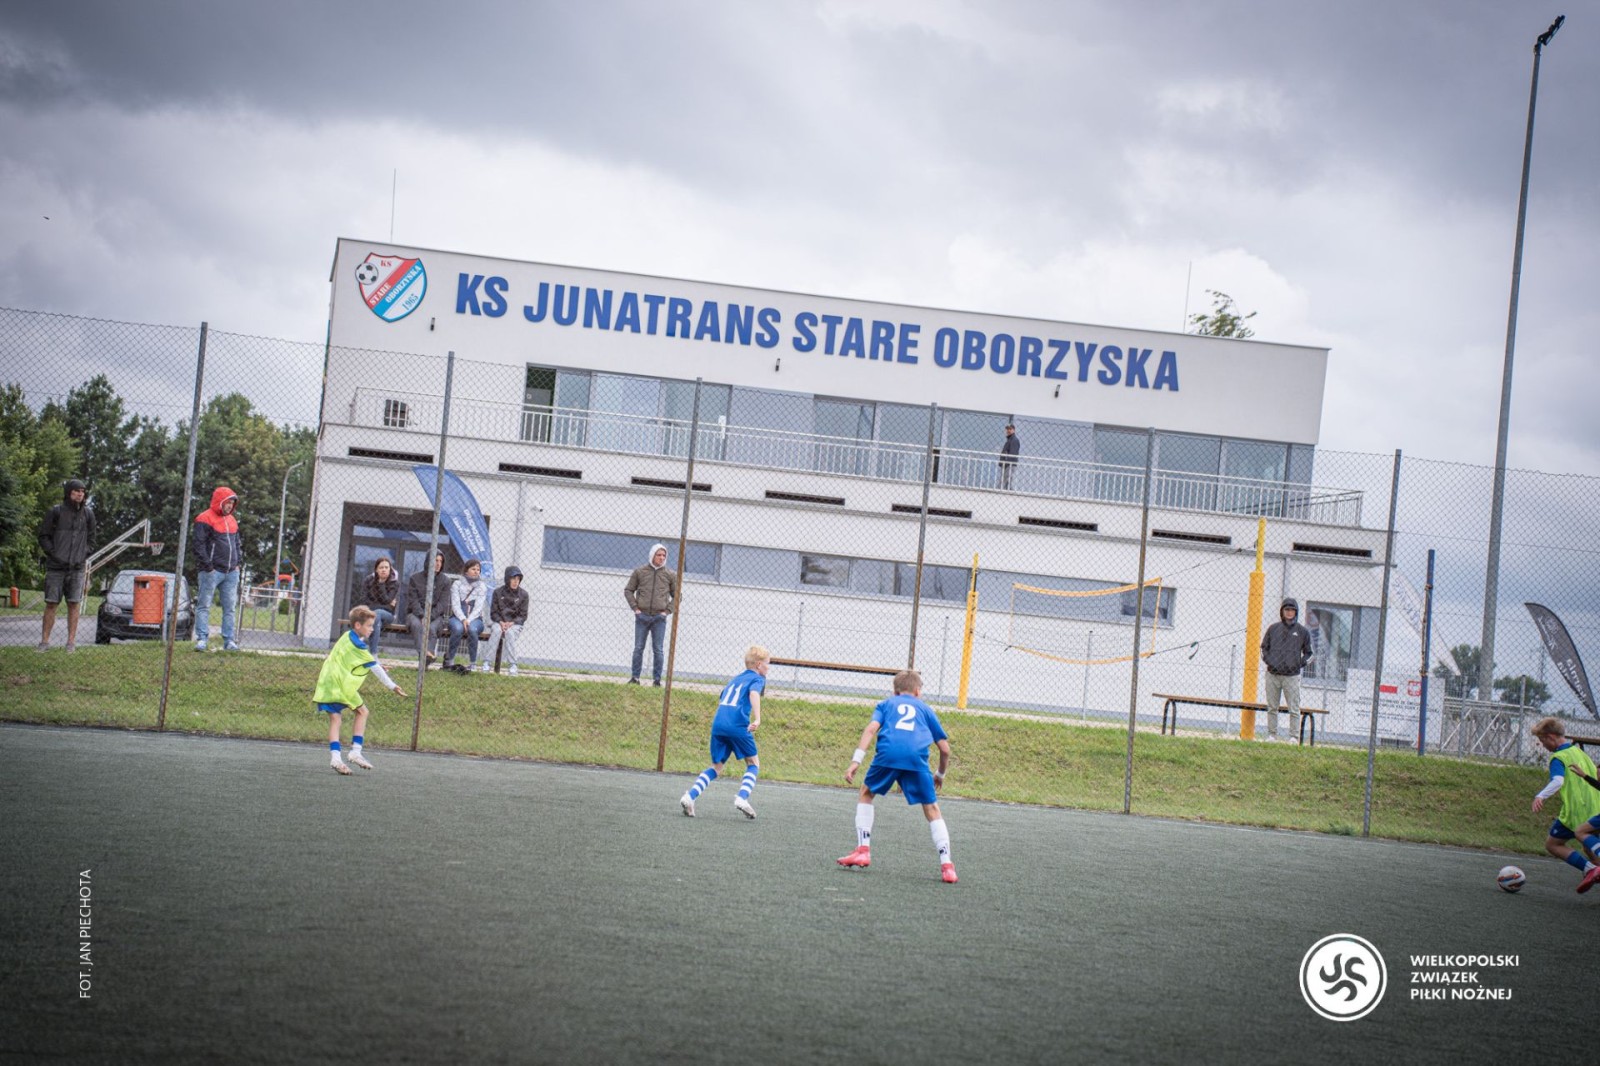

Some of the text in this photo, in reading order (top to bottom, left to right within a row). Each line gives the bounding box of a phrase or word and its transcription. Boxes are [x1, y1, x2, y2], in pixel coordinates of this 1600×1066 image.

[402, 293, 419, 310] 1965
[455, 272, 1179, 392] KS JUNATRANS STARE OBORZYSKA
[719, 683, 743, 707] 11
[894, 703, 917, 732] 2
